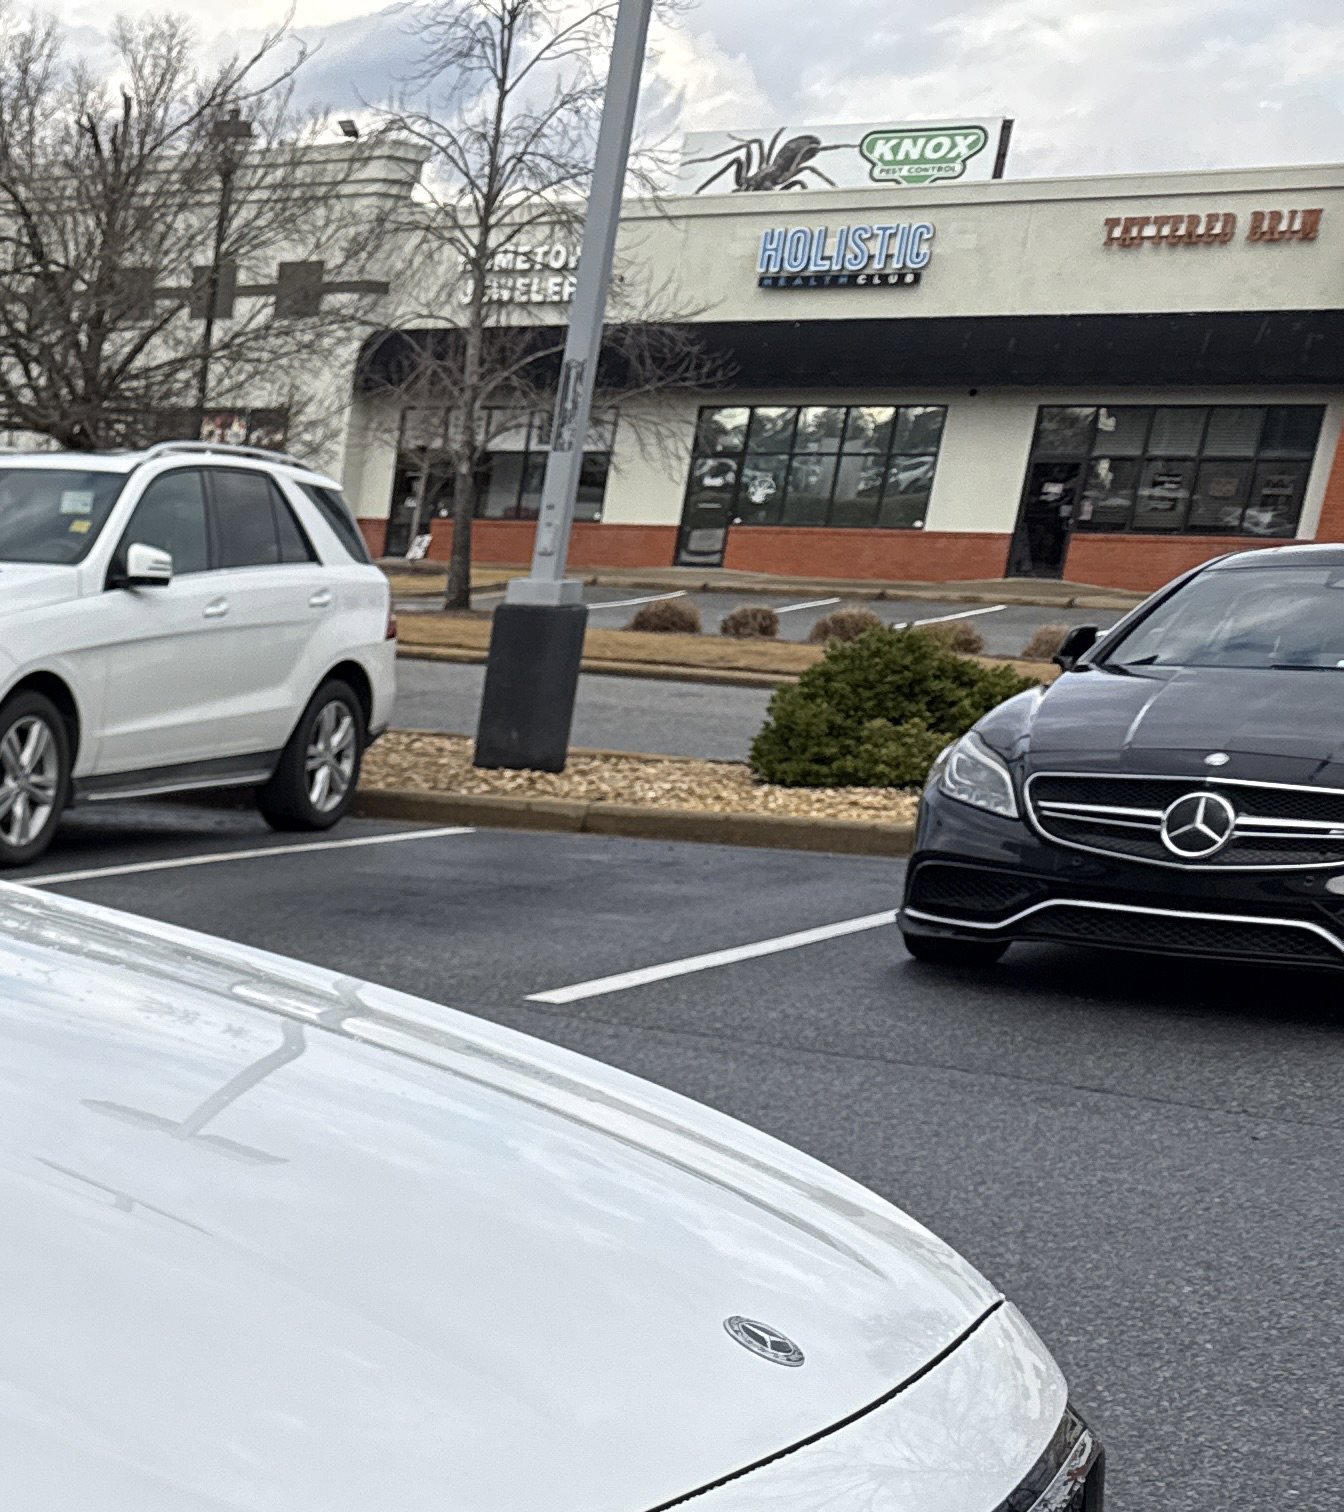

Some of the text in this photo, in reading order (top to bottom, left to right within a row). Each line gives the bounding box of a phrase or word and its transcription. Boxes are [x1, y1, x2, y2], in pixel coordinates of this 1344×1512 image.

[872, 134, 979, 161] KNOX
[880, 164, 957, 175] PEST CONTROL
[1103, 212, 1237, 247] TATTERED
[756, 221, 935, 273] HOLISTIC
